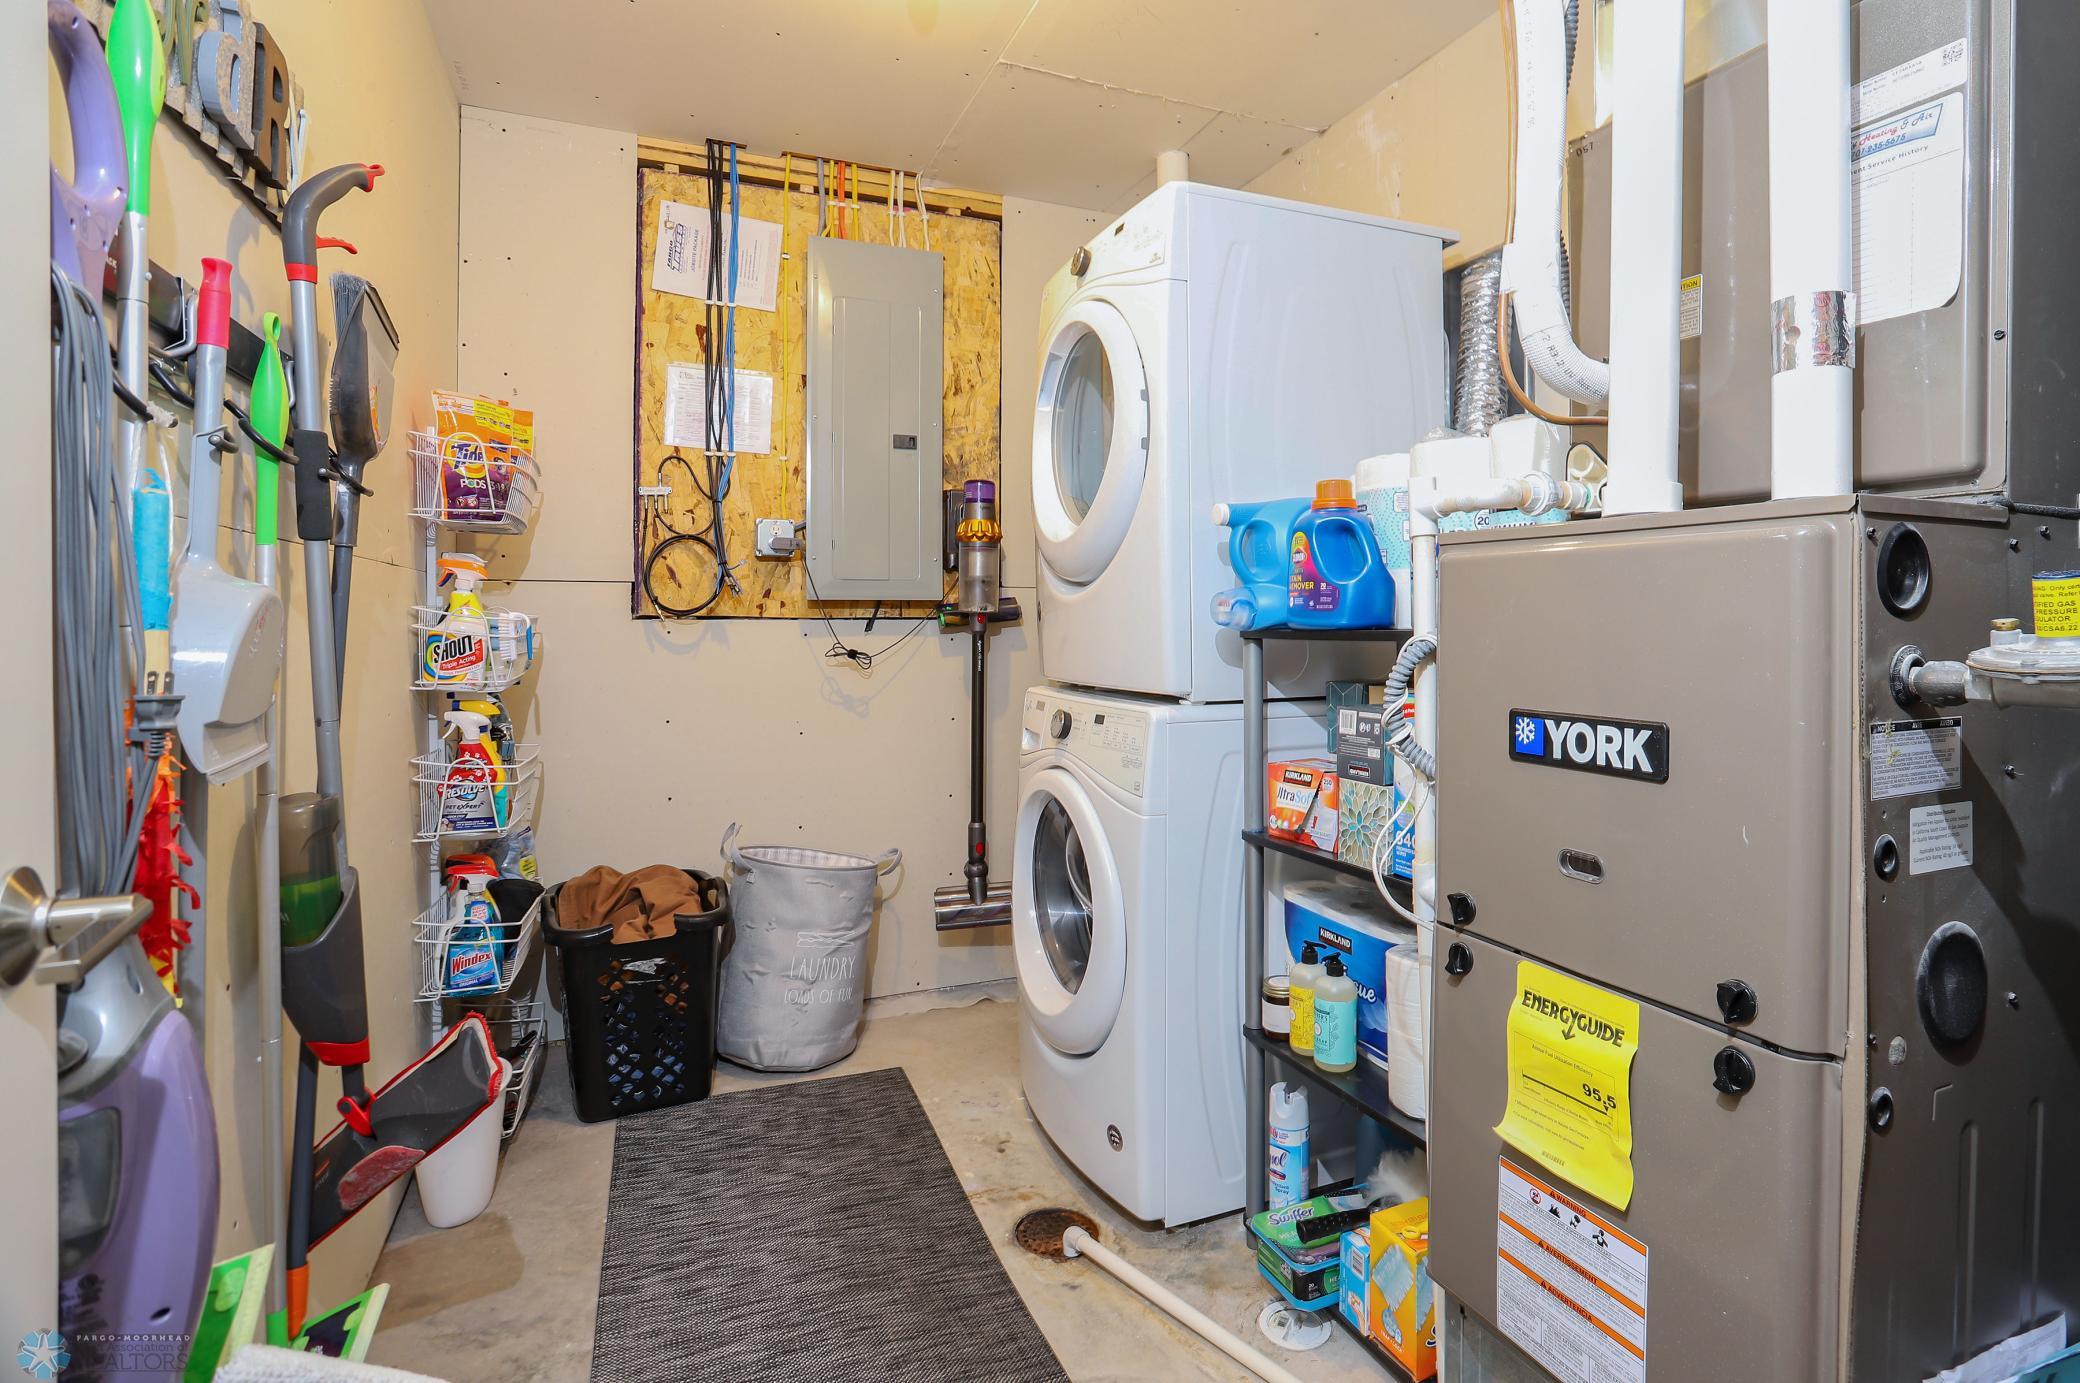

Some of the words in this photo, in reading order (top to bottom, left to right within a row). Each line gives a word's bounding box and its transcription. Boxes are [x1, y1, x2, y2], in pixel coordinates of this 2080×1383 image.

[1859, 122, 1899, 147] Heating
[1900, 118, 1911, 131] &
[1911, 109, 1934, 128] Air
[1867, 154, 1896, 171] Service
[1898, 143, 1930, 161] History
[1680, 279, 1699, 292] TION
[451, 442, 484, 470] Tide
[460, 478, 486, 488] PODS
[1290, 581, 1315, 591] EMOVER
[433, 635, 473, 664] SHOUT
[442, 660, 458, 669] Triple
[459, 654, 476, 664] Acting
[1545, 720, 1653, 774] YORK
[1285, 771, 1312, 782] KIRKLAND
[446, 784, 485, 799] RESOLVE
[1320, 928, 1351, 949] KIRKLAND
[451, 951, 492, 973] Windex
[459, 978, 479, 987] ORIGINAL
[1521, 989, 1626, 1048] ENERGYGUIDE
[1582, 1083, 1617, 1110] 95.5
[1268, 1206, 1315, 1226] Swiffer
[1555, 1194, 1587, 1218] WARNING
[1545, 1241, 1598, 1285] AVERTISSEMENT
[1547, 1284, 1593, 1323] ADVERTENCIA
